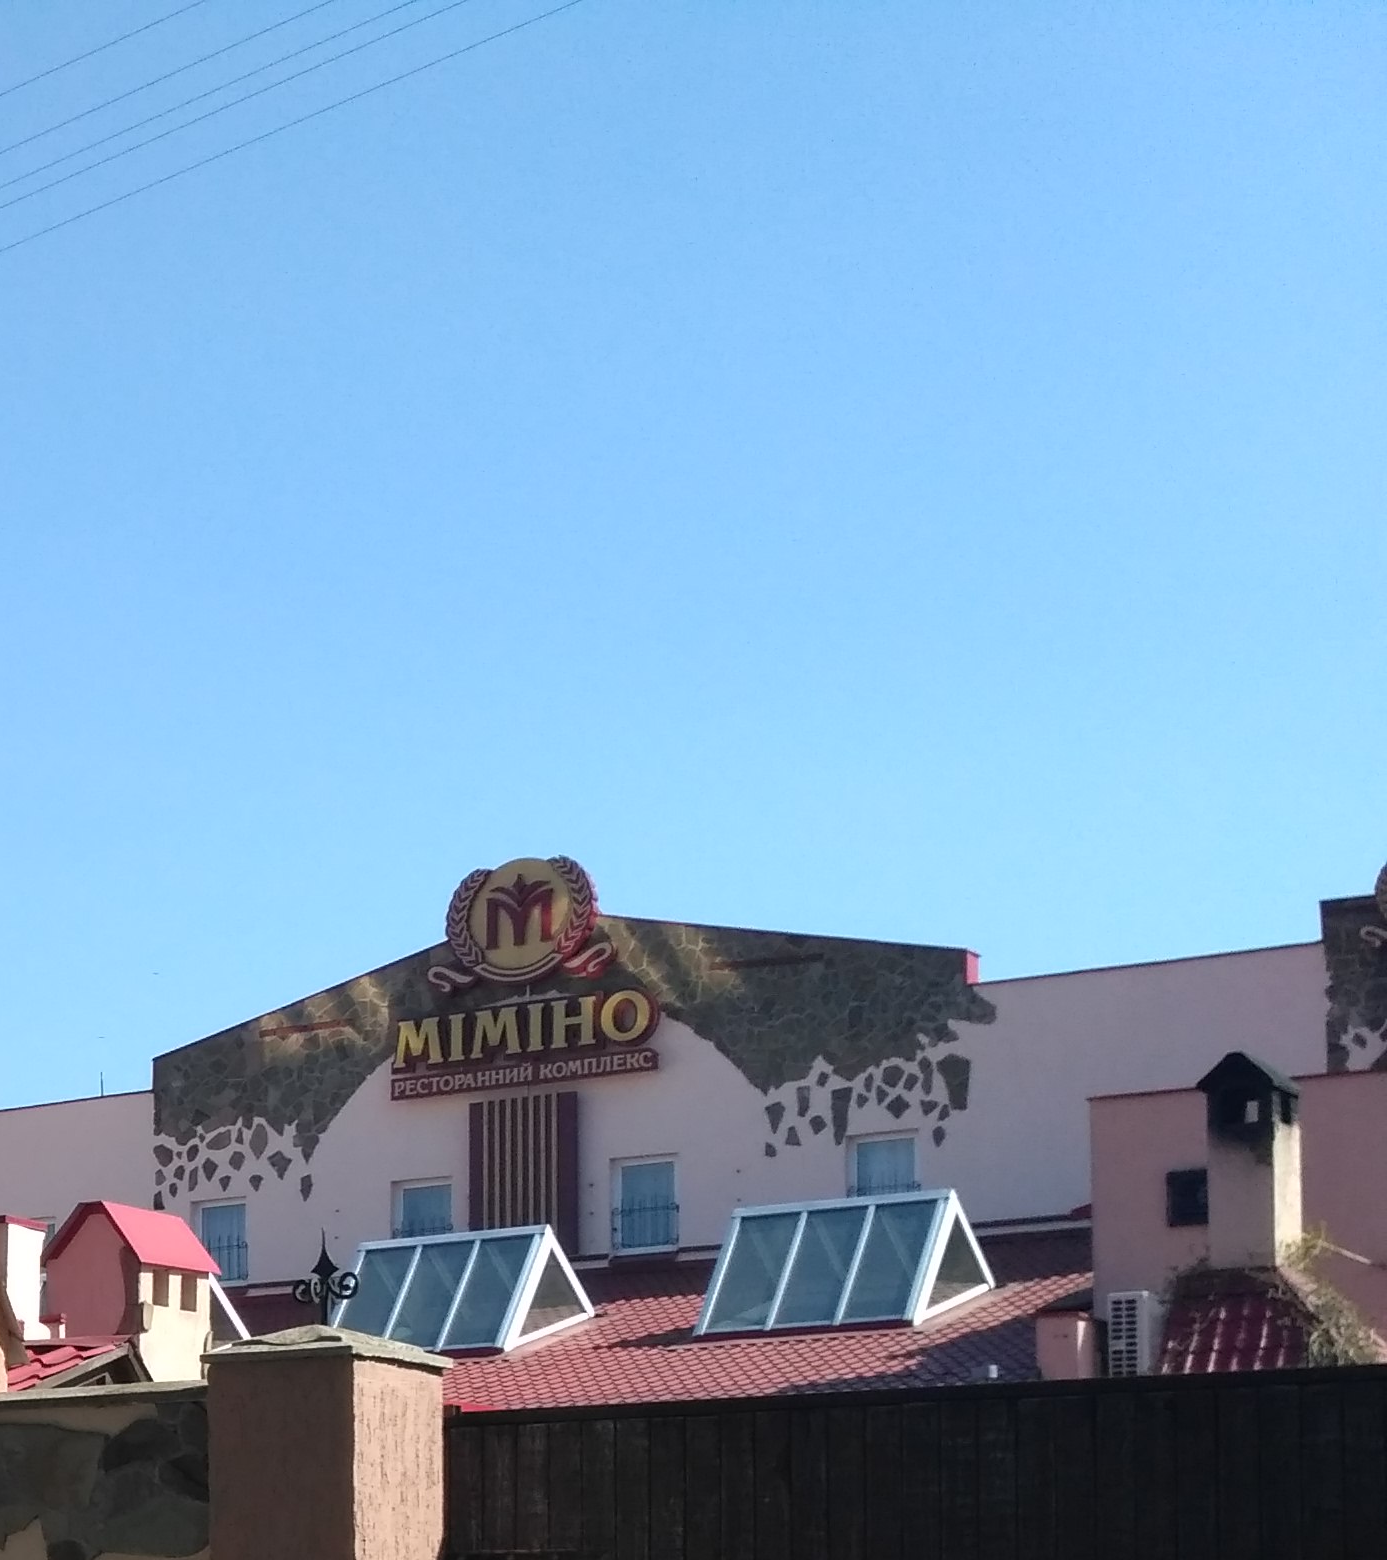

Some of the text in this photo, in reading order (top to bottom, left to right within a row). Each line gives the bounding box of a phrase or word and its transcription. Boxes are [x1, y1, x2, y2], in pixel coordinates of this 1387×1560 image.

[393, 989, 652, 1069] МІМІНО
[393, 1050, 654, 1098] РЕСТОРАННИЙ КОМПЛЕКС
